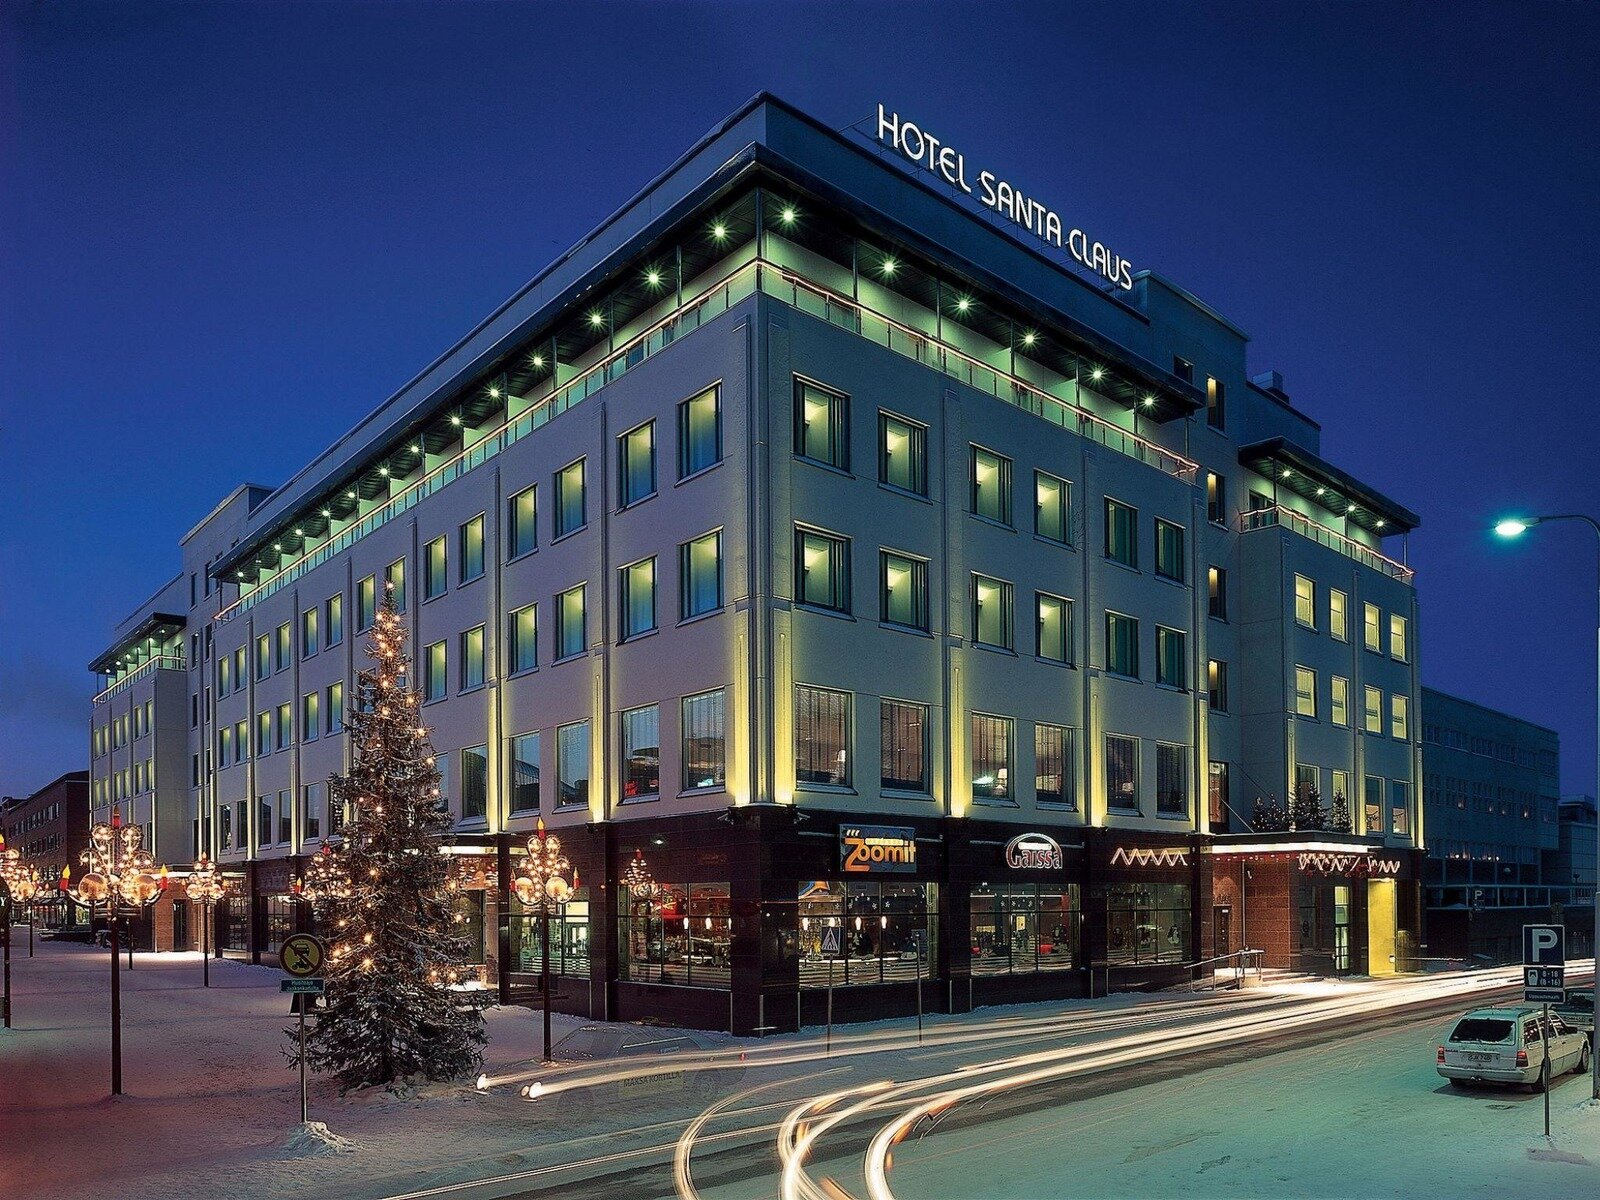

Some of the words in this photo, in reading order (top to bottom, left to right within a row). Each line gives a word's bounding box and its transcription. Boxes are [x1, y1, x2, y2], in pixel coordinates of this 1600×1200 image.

[878, 102, 971, 193] HOTEL
[980, 170, 1061, 247] SANTA
[1068, 229, 1132, 290] CLAUS
[844, 837, 916, 872] Zoomit
[1005, 832, 1063, 869] Gaissa
[1532, 928, 1558, 962] P
